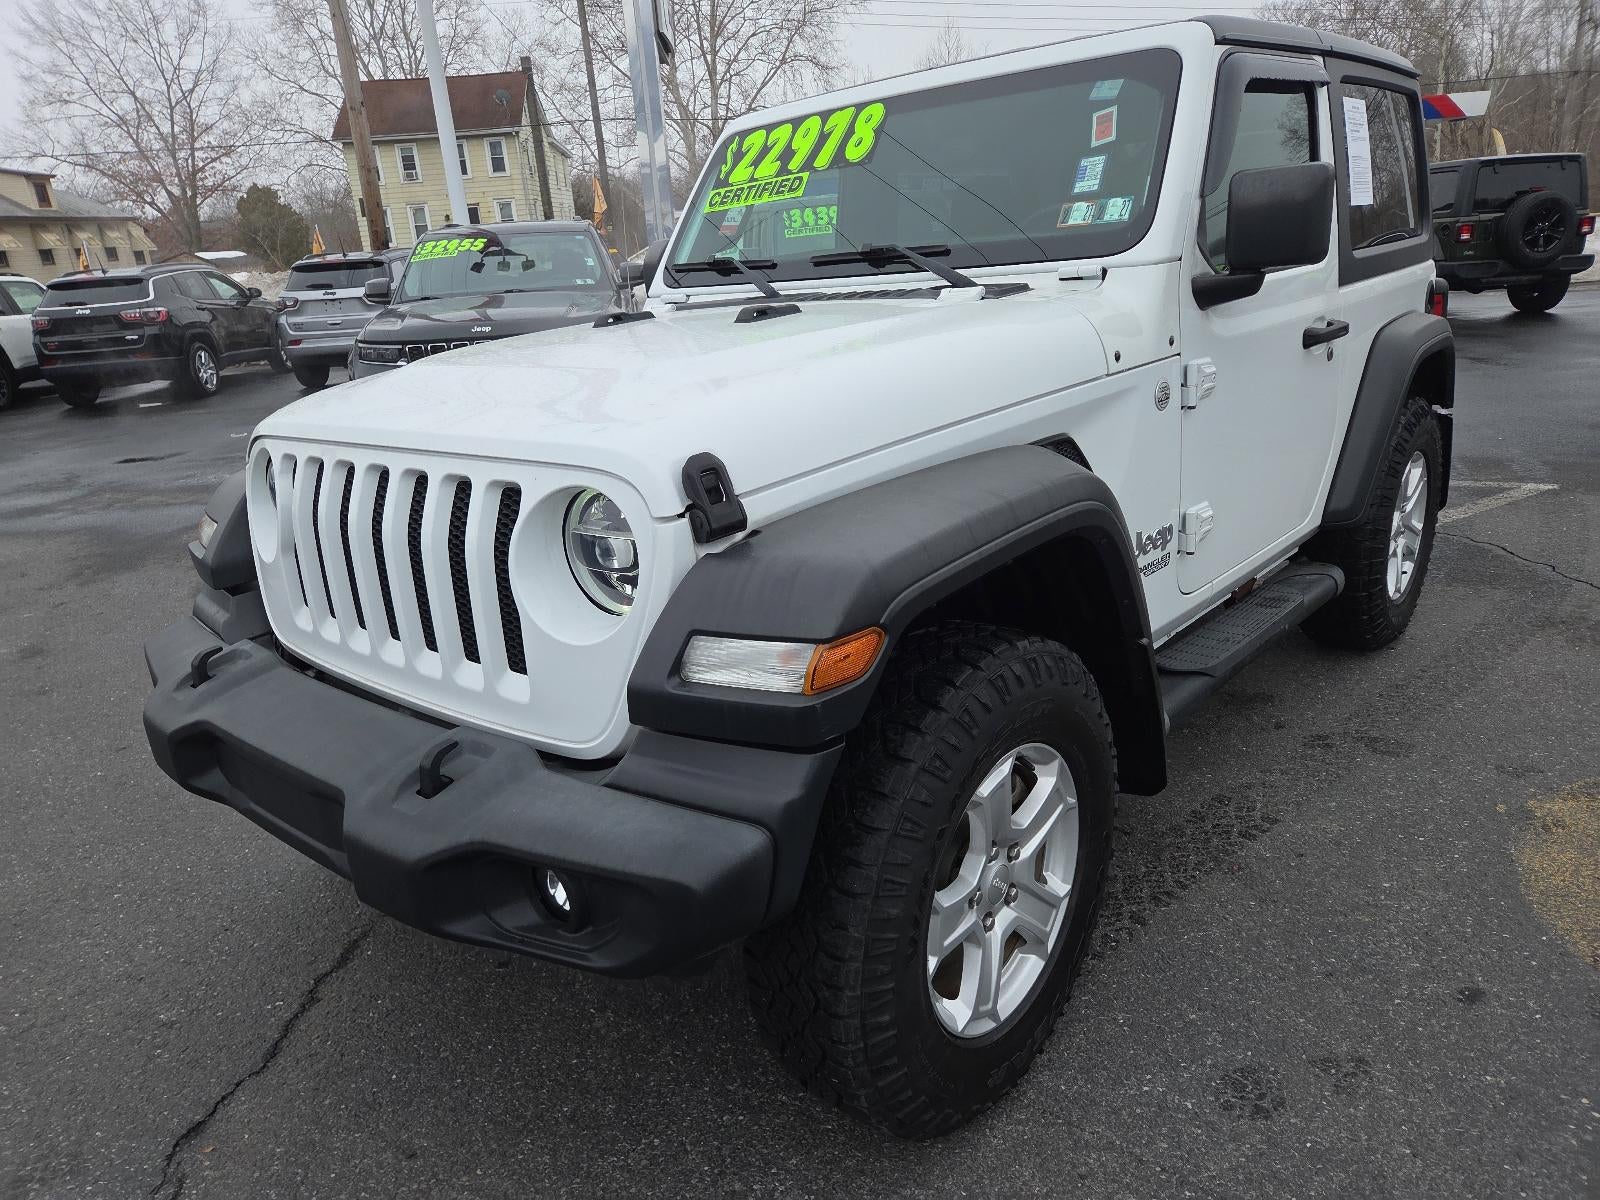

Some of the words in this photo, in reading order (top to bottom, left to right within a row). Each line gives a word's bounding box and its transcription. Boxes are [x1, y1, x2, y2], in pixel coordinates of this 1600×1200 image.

[719, 102, 886, 186] $22978
[707, 175, 804, 209] CERTIFIED
[786, 225, 830, 236] CERTIFIED
[471, 325, 492, 333] Jeep
[1134, 522, 1173, 558] Jeep
